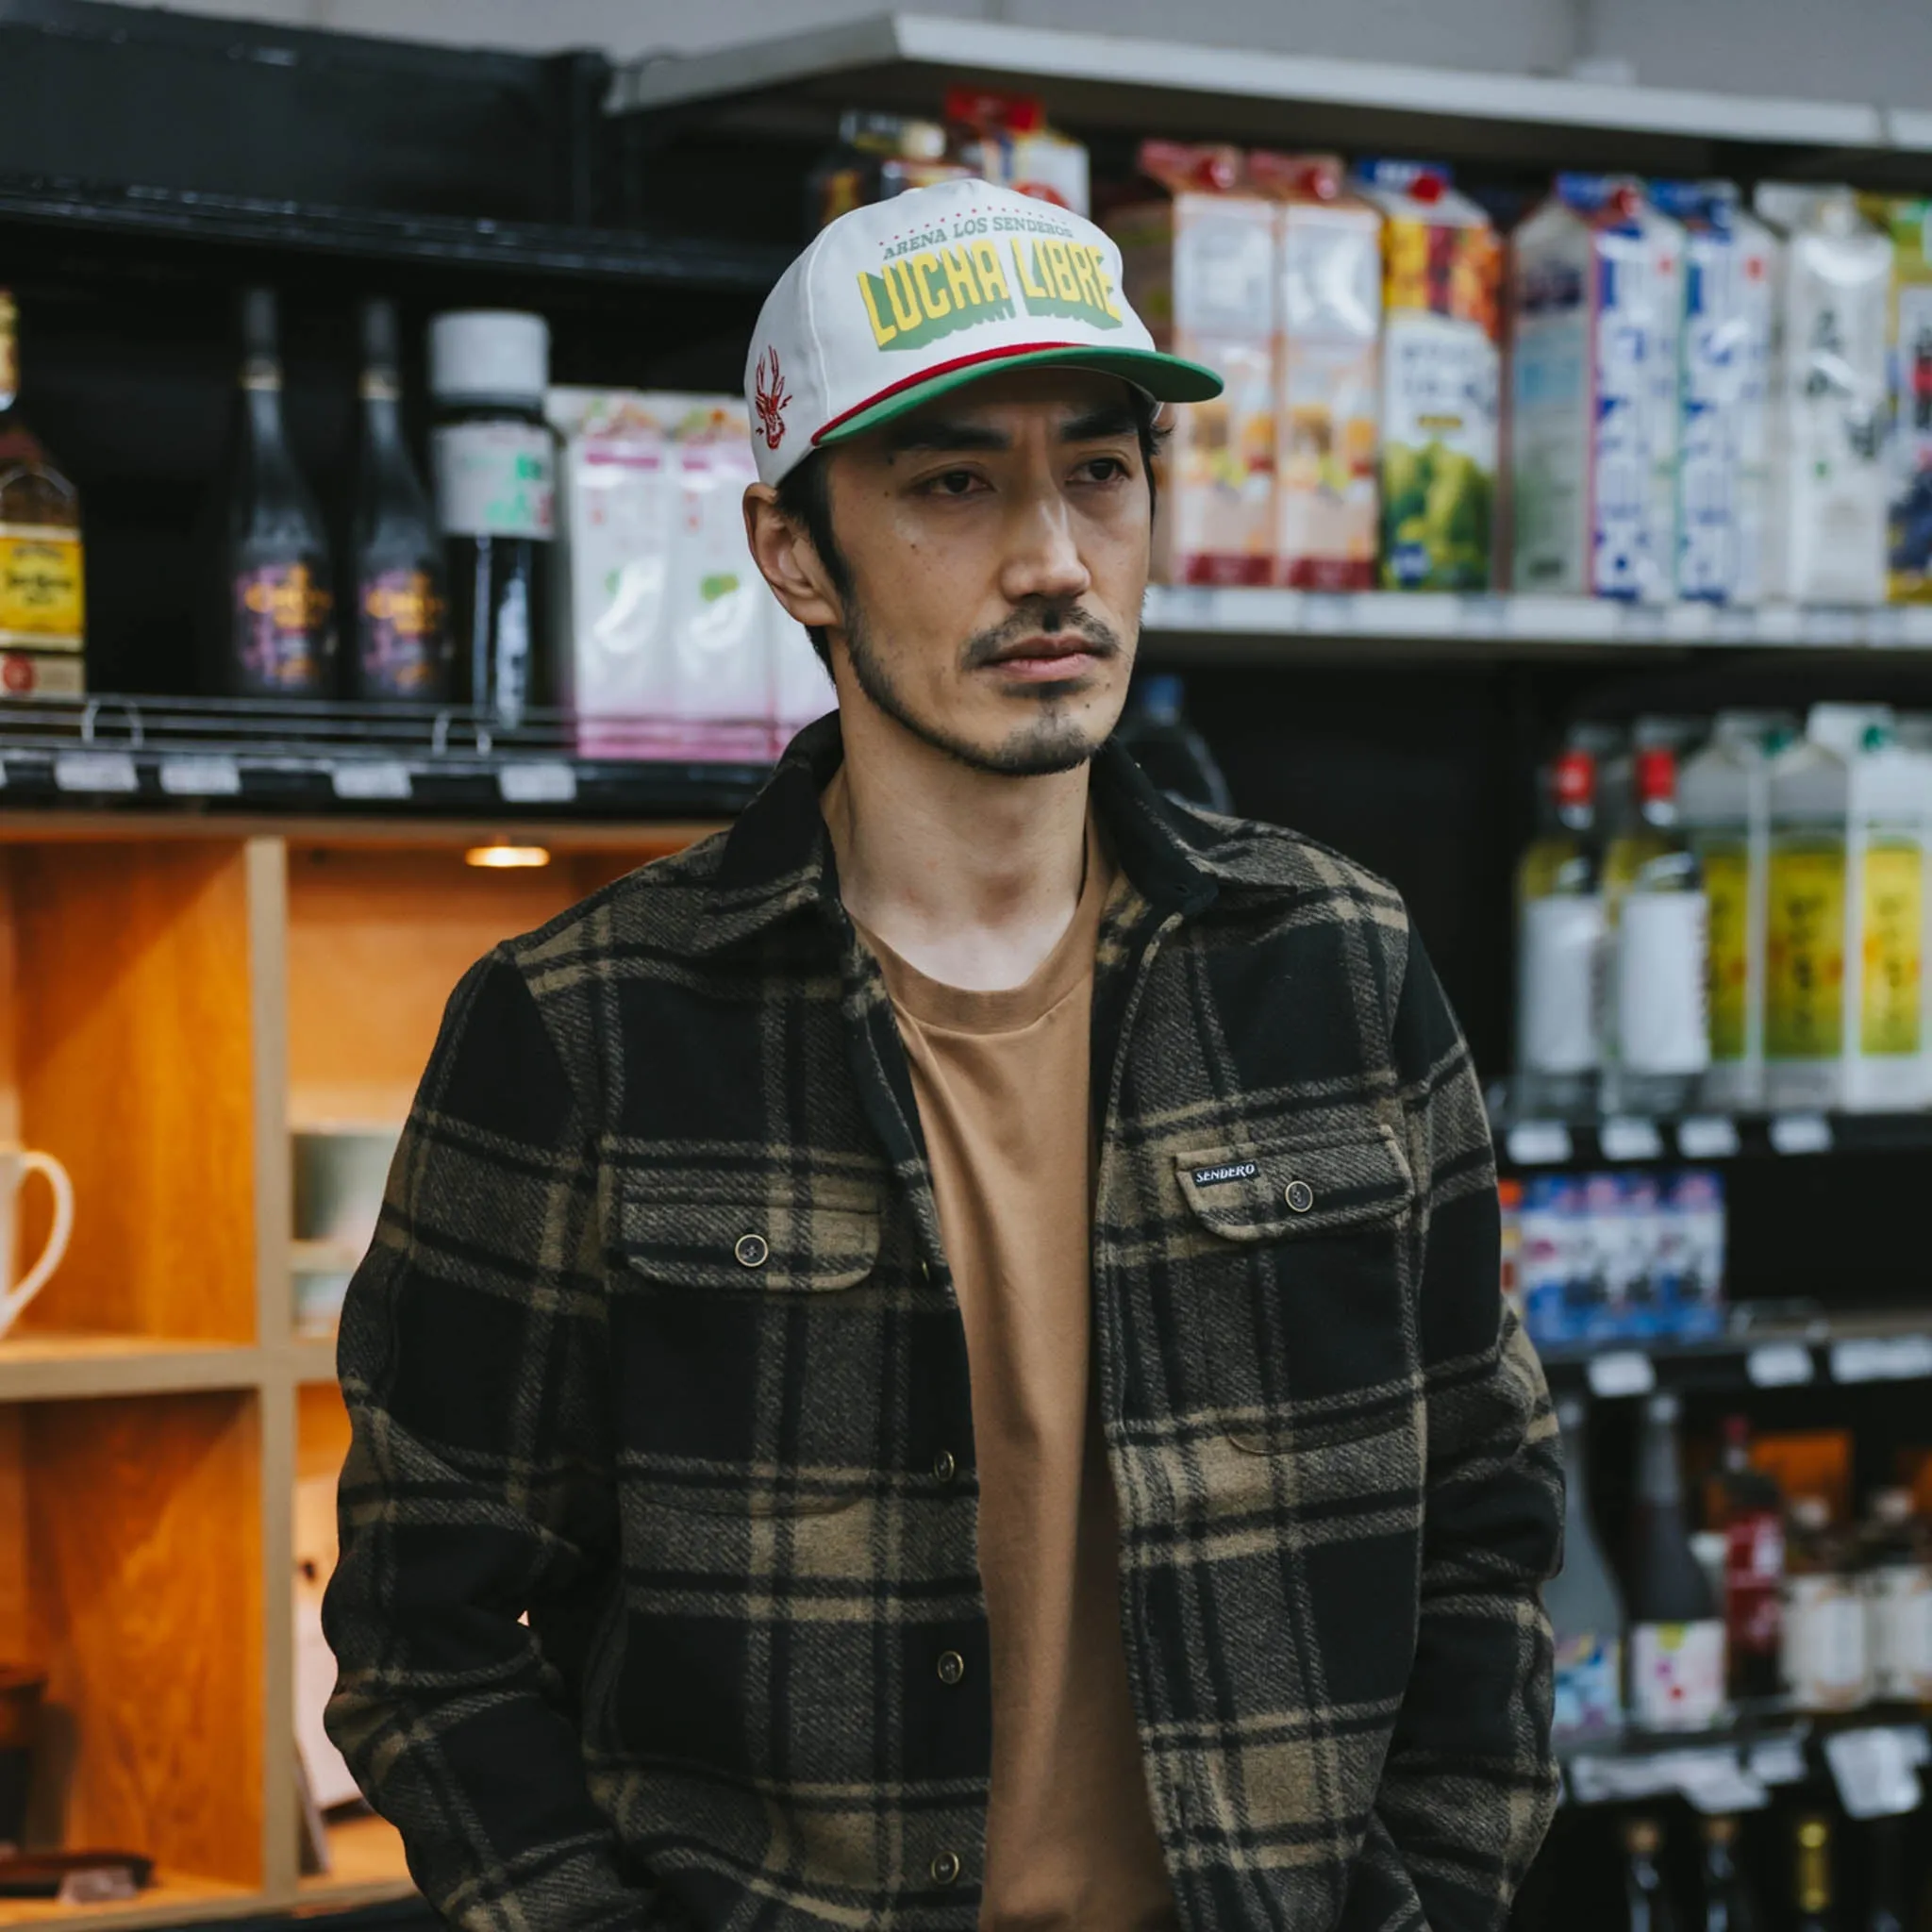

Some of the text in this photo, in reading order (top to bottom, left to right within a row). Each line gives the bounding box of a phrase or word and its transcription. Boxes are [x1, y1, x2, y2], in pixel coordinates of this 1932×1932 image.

[883, 216, 1074, 260] ARENA LOS SENDEROS
[856, 236, 1123, 350] LUCHA LIBRE
[1195, 1163, 1256, 1183] SENDERO
